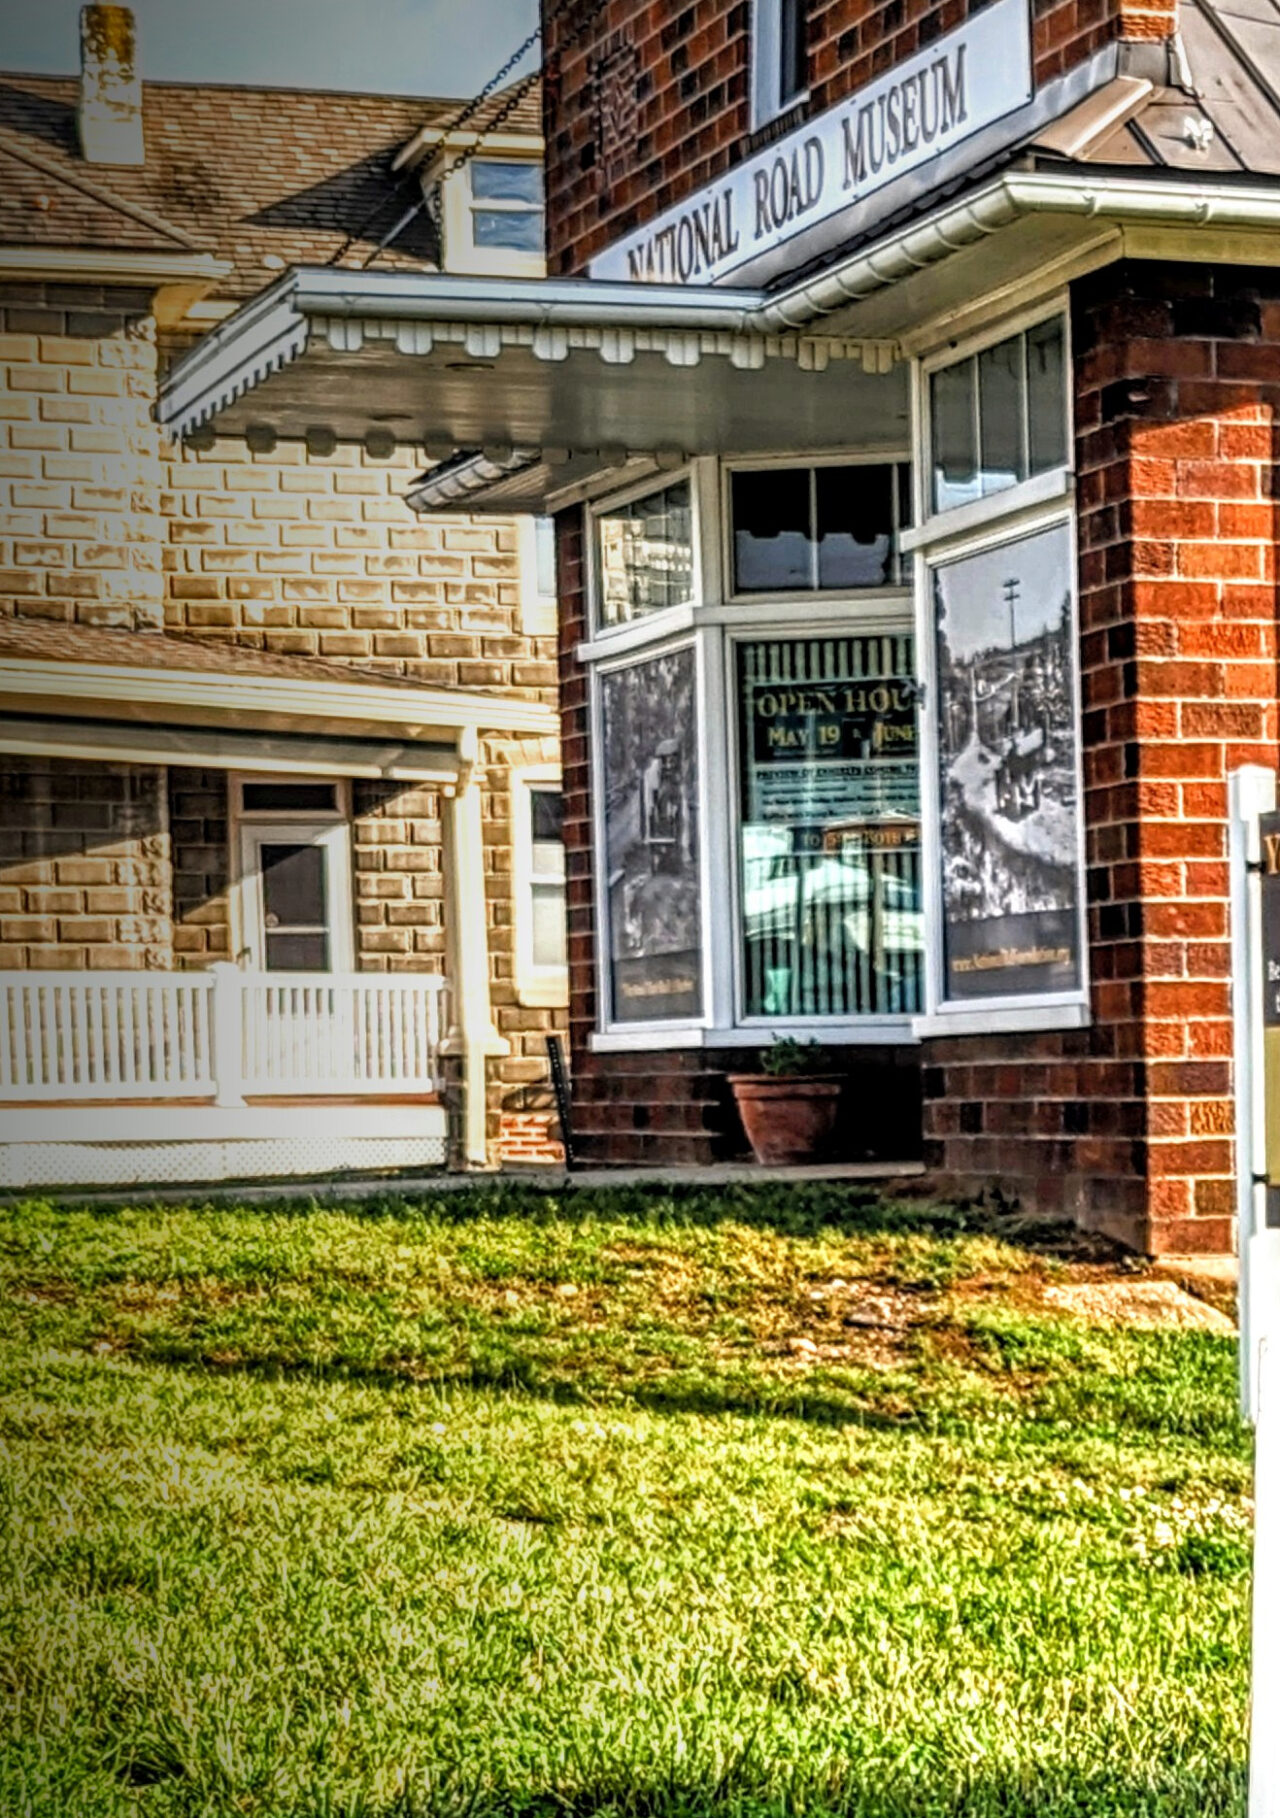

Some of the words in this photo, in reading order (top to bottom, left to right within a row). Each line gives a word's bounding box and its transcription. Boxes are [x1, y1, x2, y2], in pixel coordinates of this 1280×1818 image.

[627, 189, 739, 282] NATIONAL
[754, 137, 824, 240] ROAD
[842, 44, 968, 190] MUSEUM
[757, 691, 836, 718] OPEN
[768, 726, 810, 747] MAY
[818, 725, 840, 745] 19
[1268, 960, 1280, 982] Be
